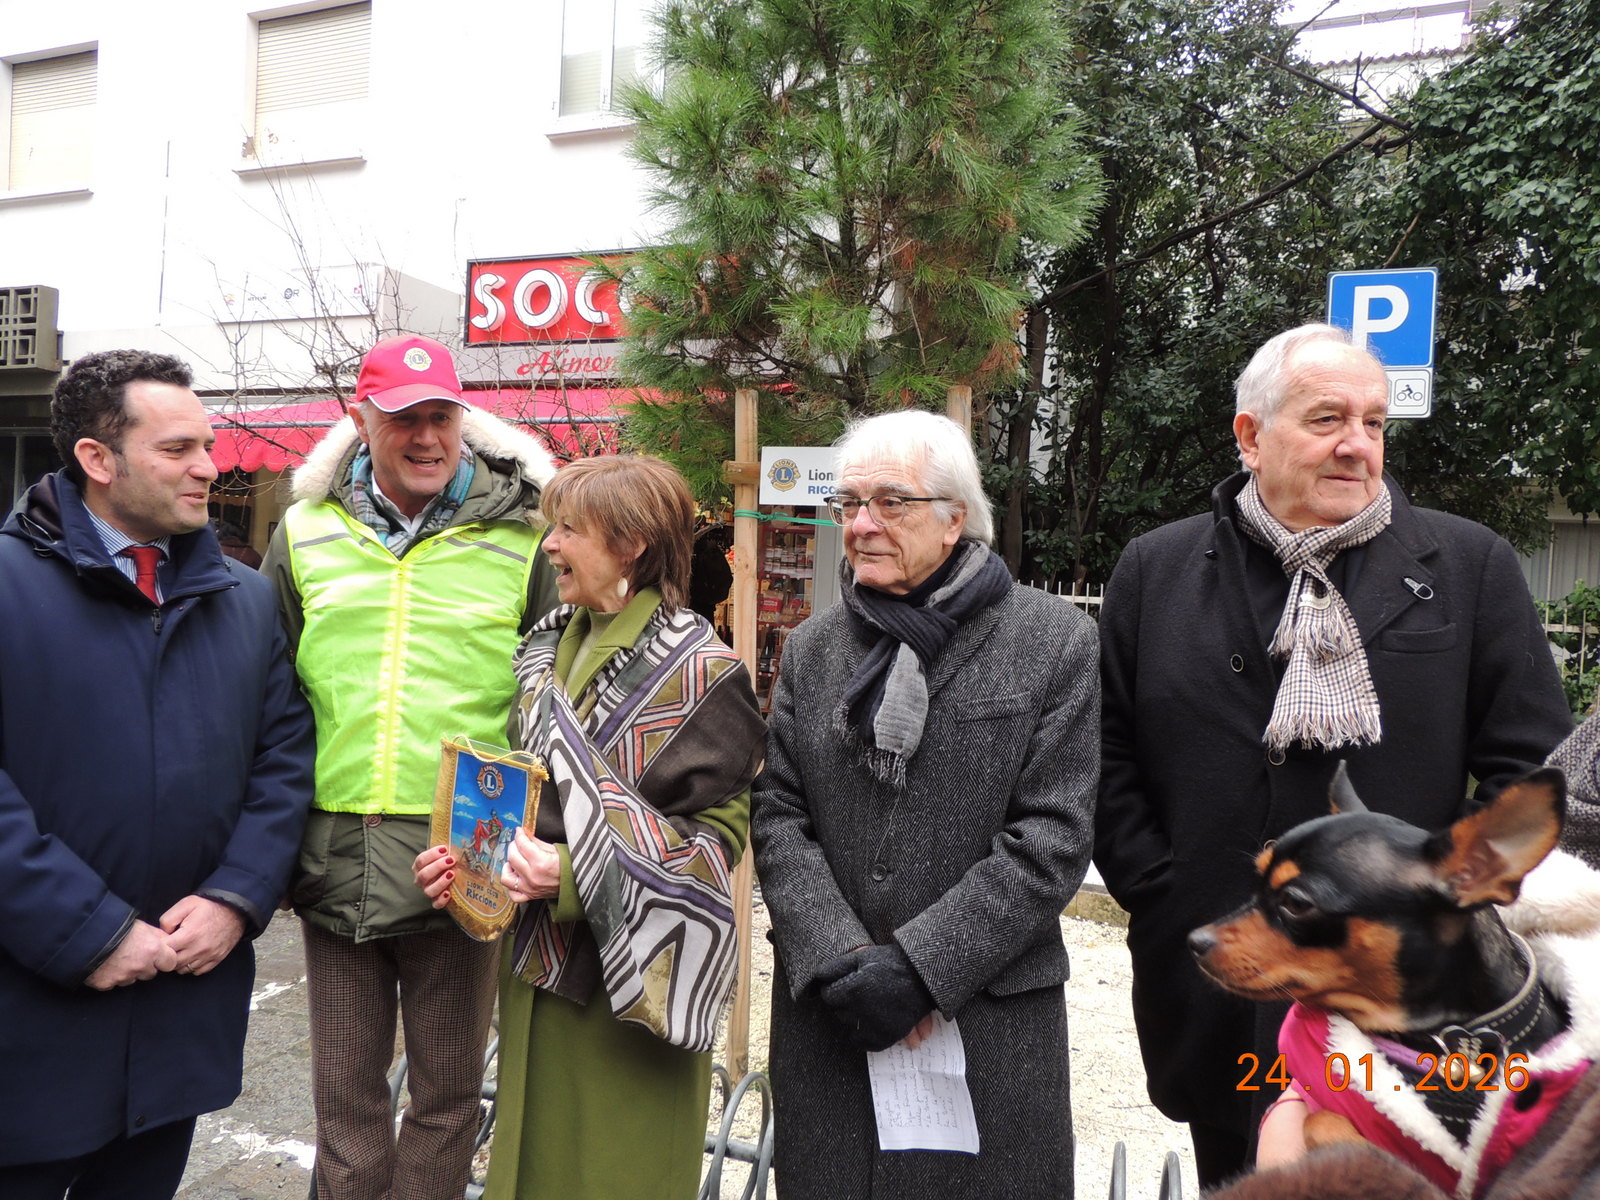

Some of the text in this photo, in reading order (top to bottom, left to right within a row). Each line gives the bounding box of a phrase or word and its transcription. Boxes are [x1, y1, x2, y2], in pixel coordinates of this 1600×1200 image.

[470, 268, 636, 332] SOC
[1352, 284, 1409, 350] P
[516, 348, 630, 376] Alimen
[780, 468, 789, 481] L
[808, 468, 834, 481] Lion
[807, 485, 836, 495] RICC
[486, 774, 495, 789] L
[466, 887, 497, 910] Riccione
